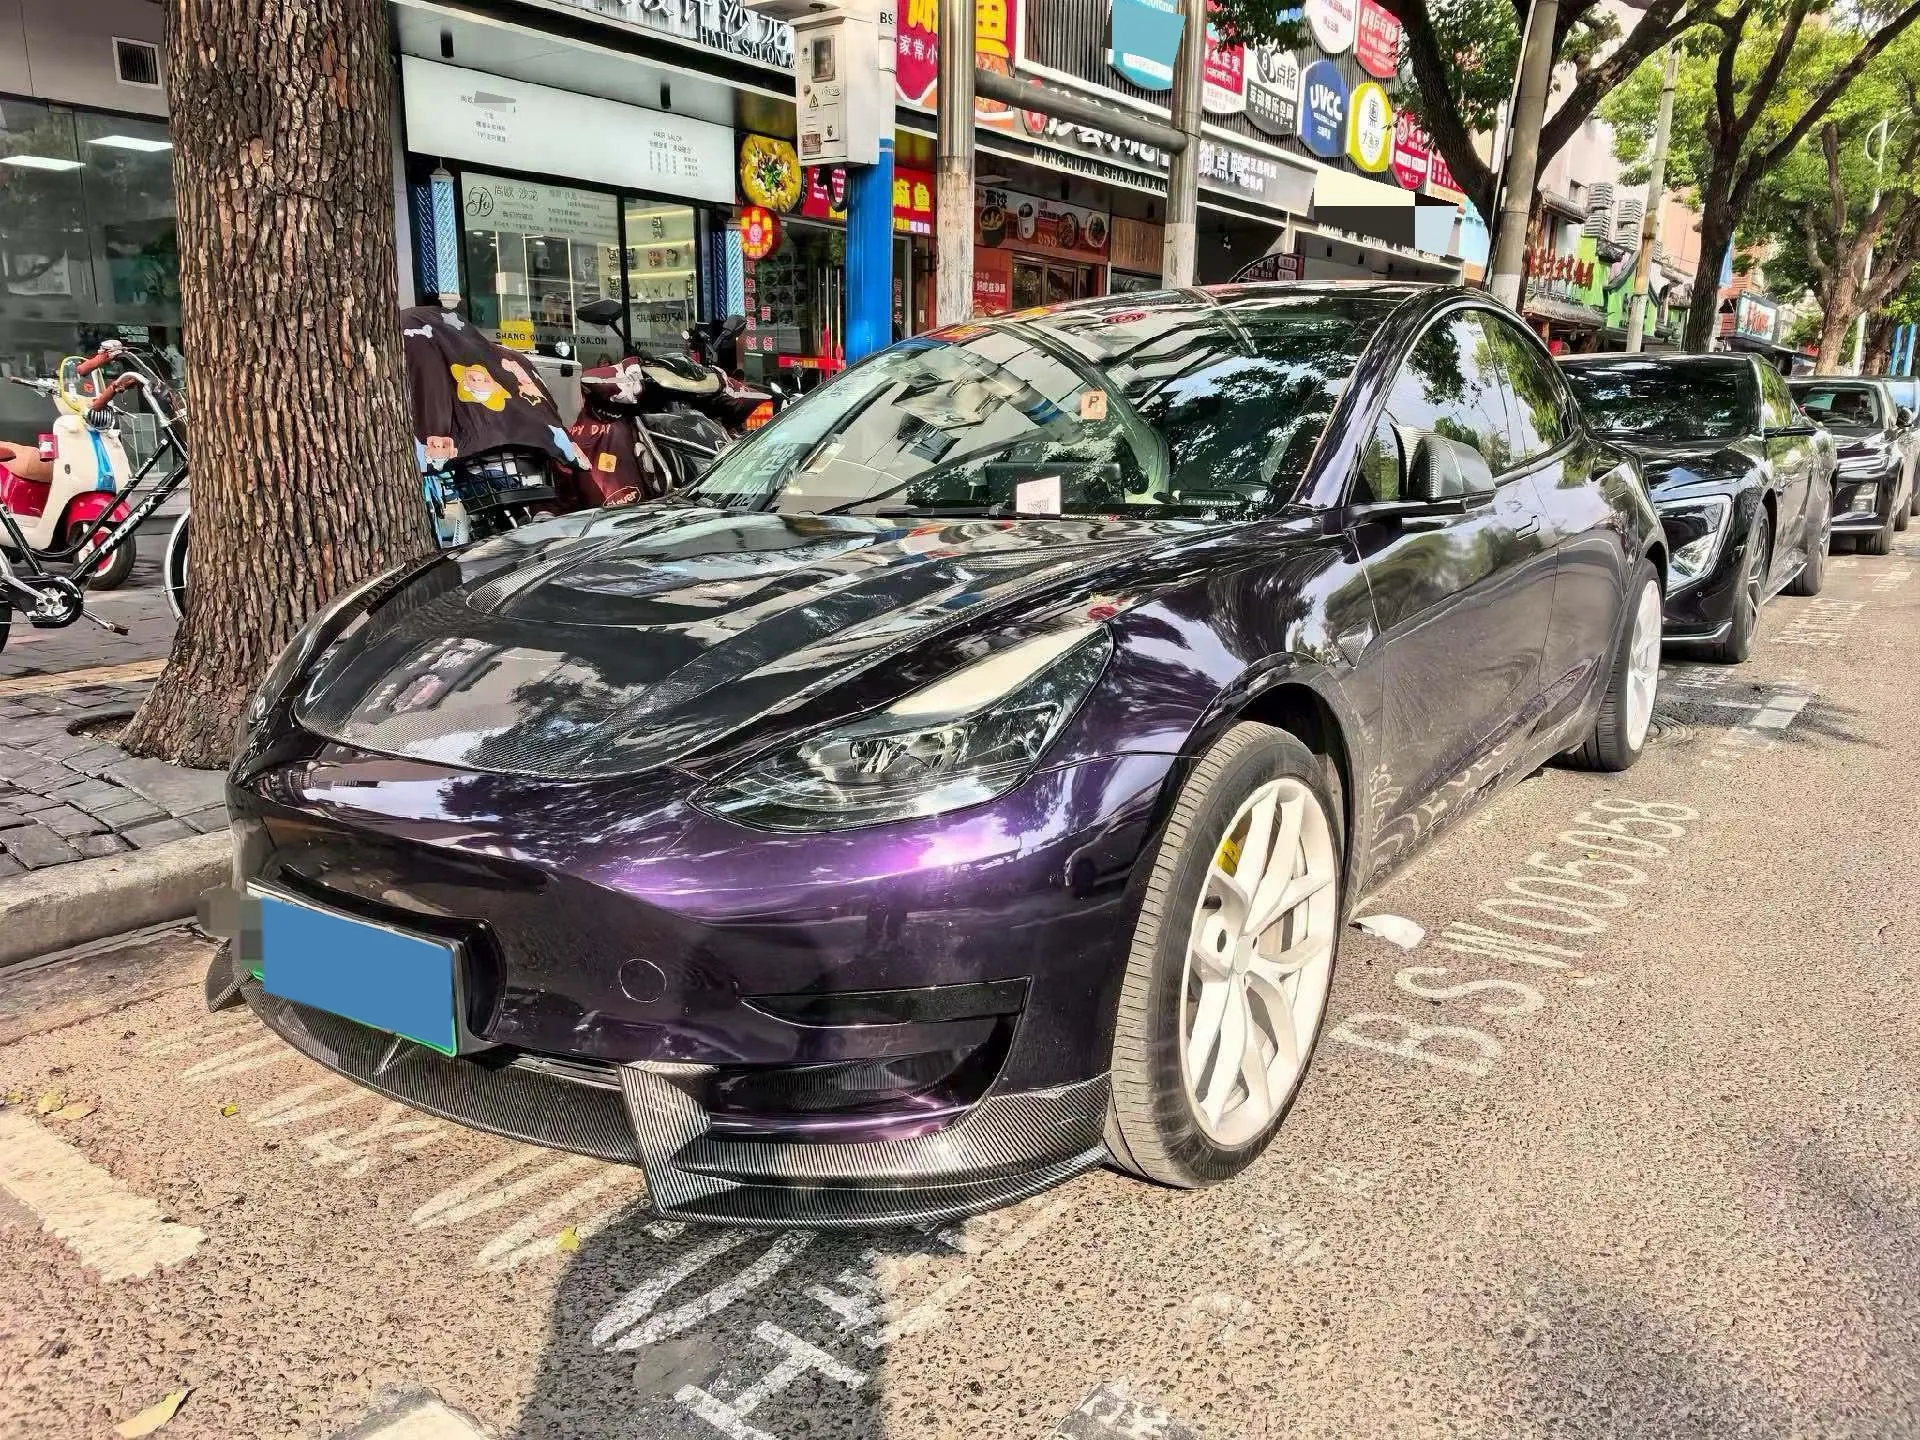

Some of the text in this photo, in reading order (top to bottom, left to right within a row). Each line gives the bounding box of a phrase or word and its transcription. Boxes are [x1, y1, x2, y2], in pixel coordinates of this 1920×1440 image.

[698, 25, 784, 68] HAIR SALON
[1032, 147, 1099, 176] MINCHUAN
[496, 332, 527, 342] SHANG
[580, 336, 608, 346] SALON
[100, 495, 156, 555] PHOENIX
